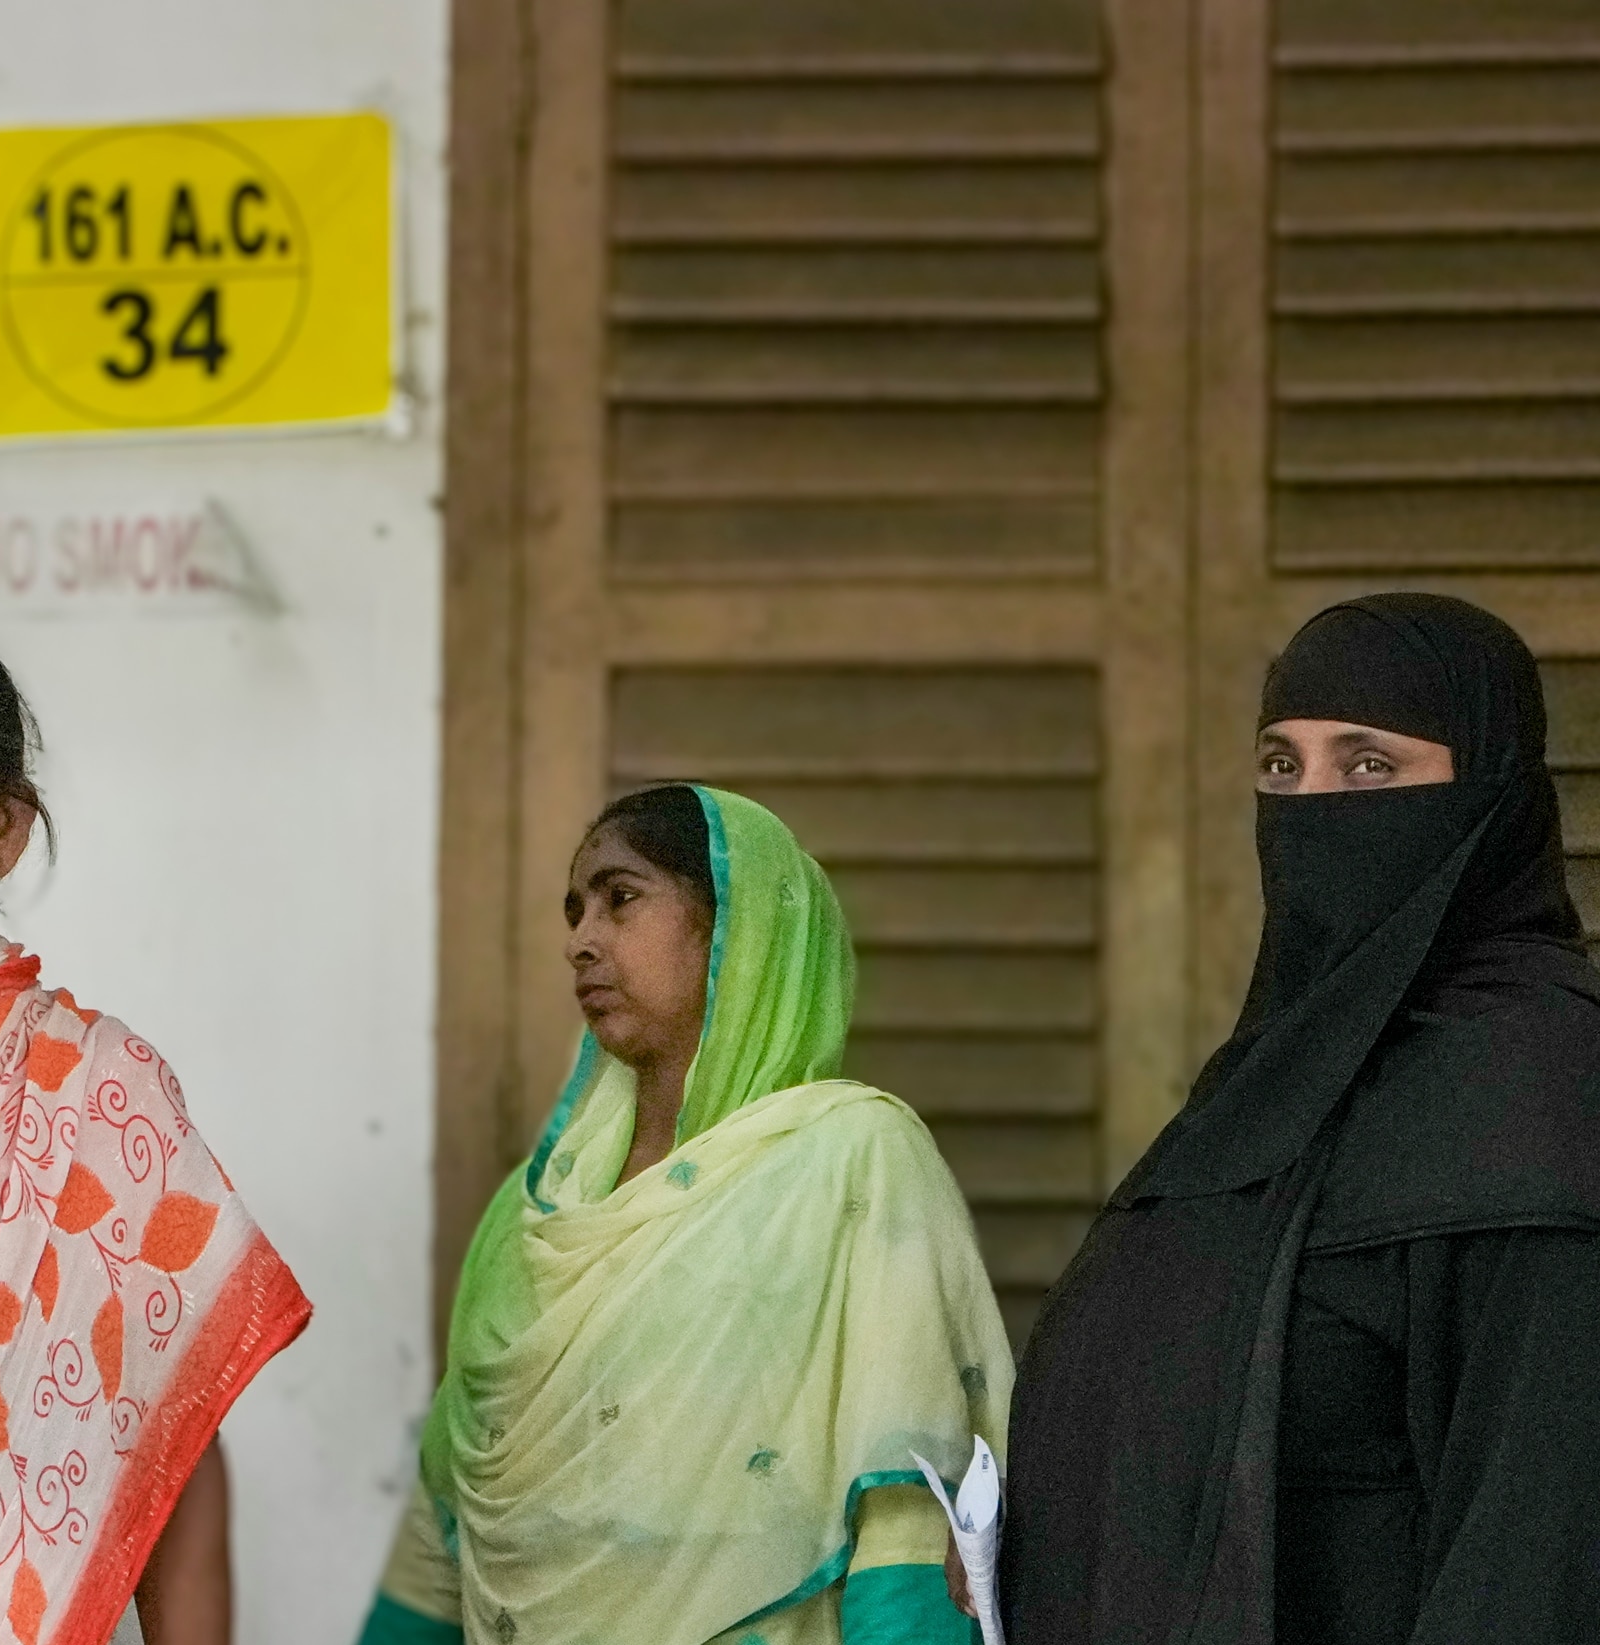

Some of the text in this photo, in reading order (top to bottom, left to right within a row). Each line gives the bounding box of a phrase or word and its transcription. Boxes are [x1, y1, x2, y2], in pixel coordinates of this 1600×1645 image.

[30, 180, 290, 263] 161 A.C.
[101, 284, 231, 383] 34
